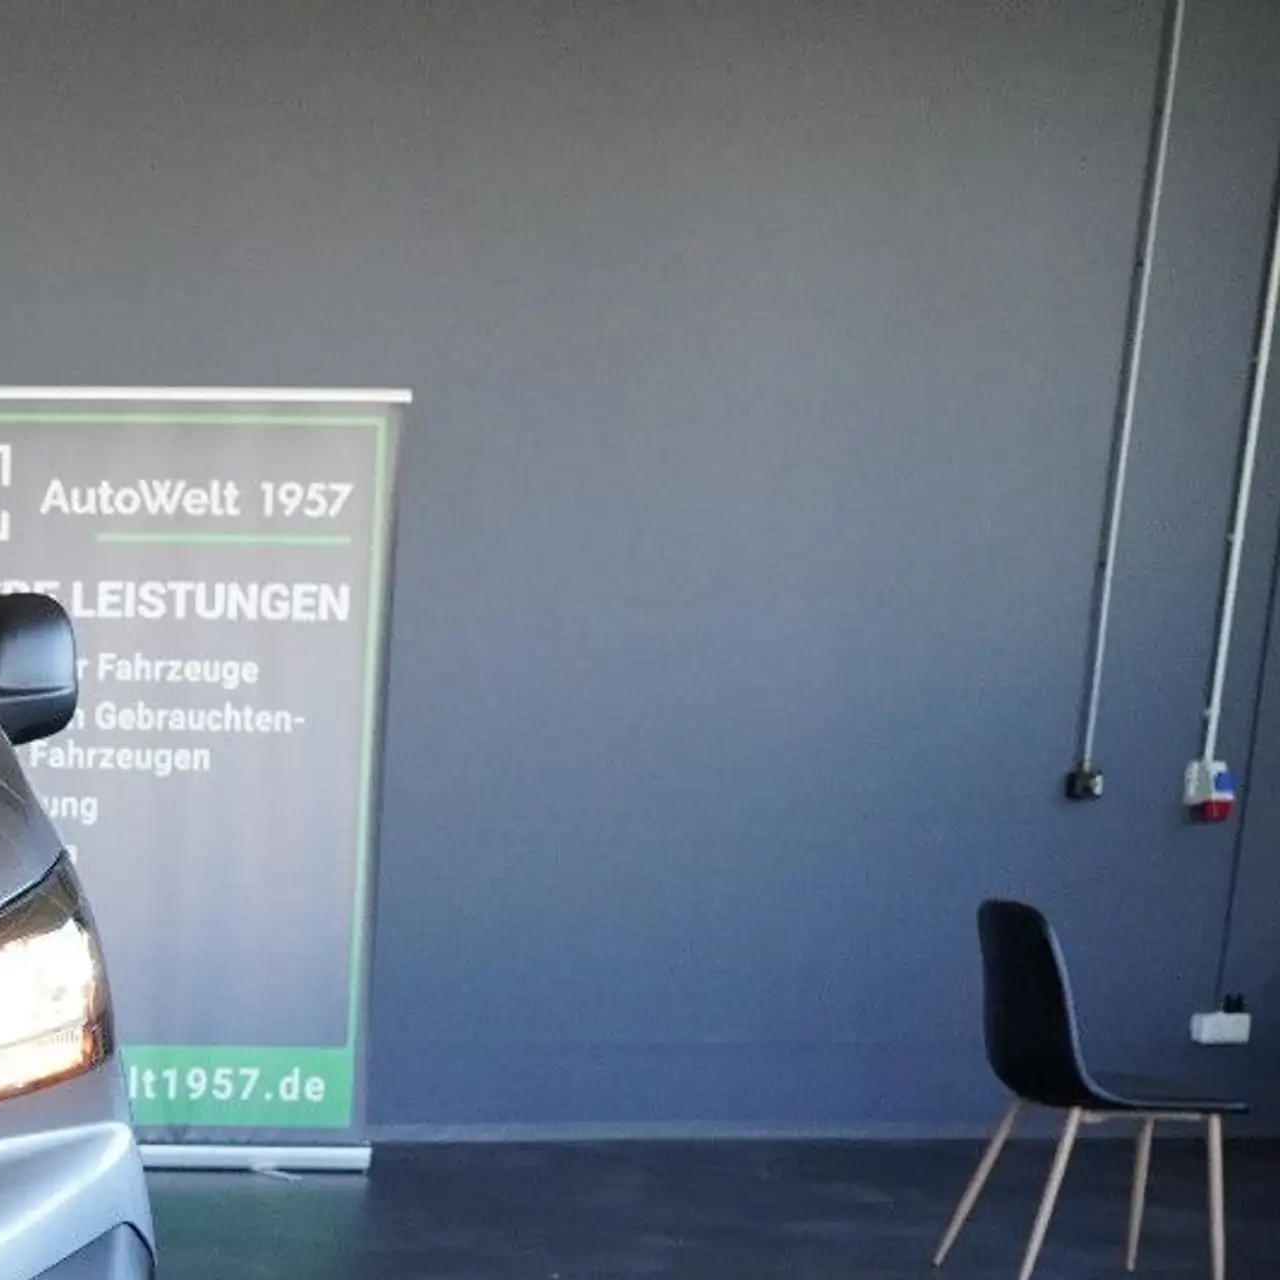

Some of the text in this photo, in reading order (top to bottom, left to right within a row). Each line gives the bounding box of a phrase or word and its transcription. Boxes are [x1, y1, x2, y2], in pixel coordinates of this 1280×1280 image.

[39, 479, 240, 517] AutoWelt
[260, 482, 355, 518] 1957
[71, 579, 350, 622] LEISTUNGEN
[97, 652, 259, 690] Fahrzeuge
[94, 702, 305, 734] Gebrauchten-
[29, 740, 211, 778] Fahrzeugen
[128, 1065, 326, 1101] lt1957.de
